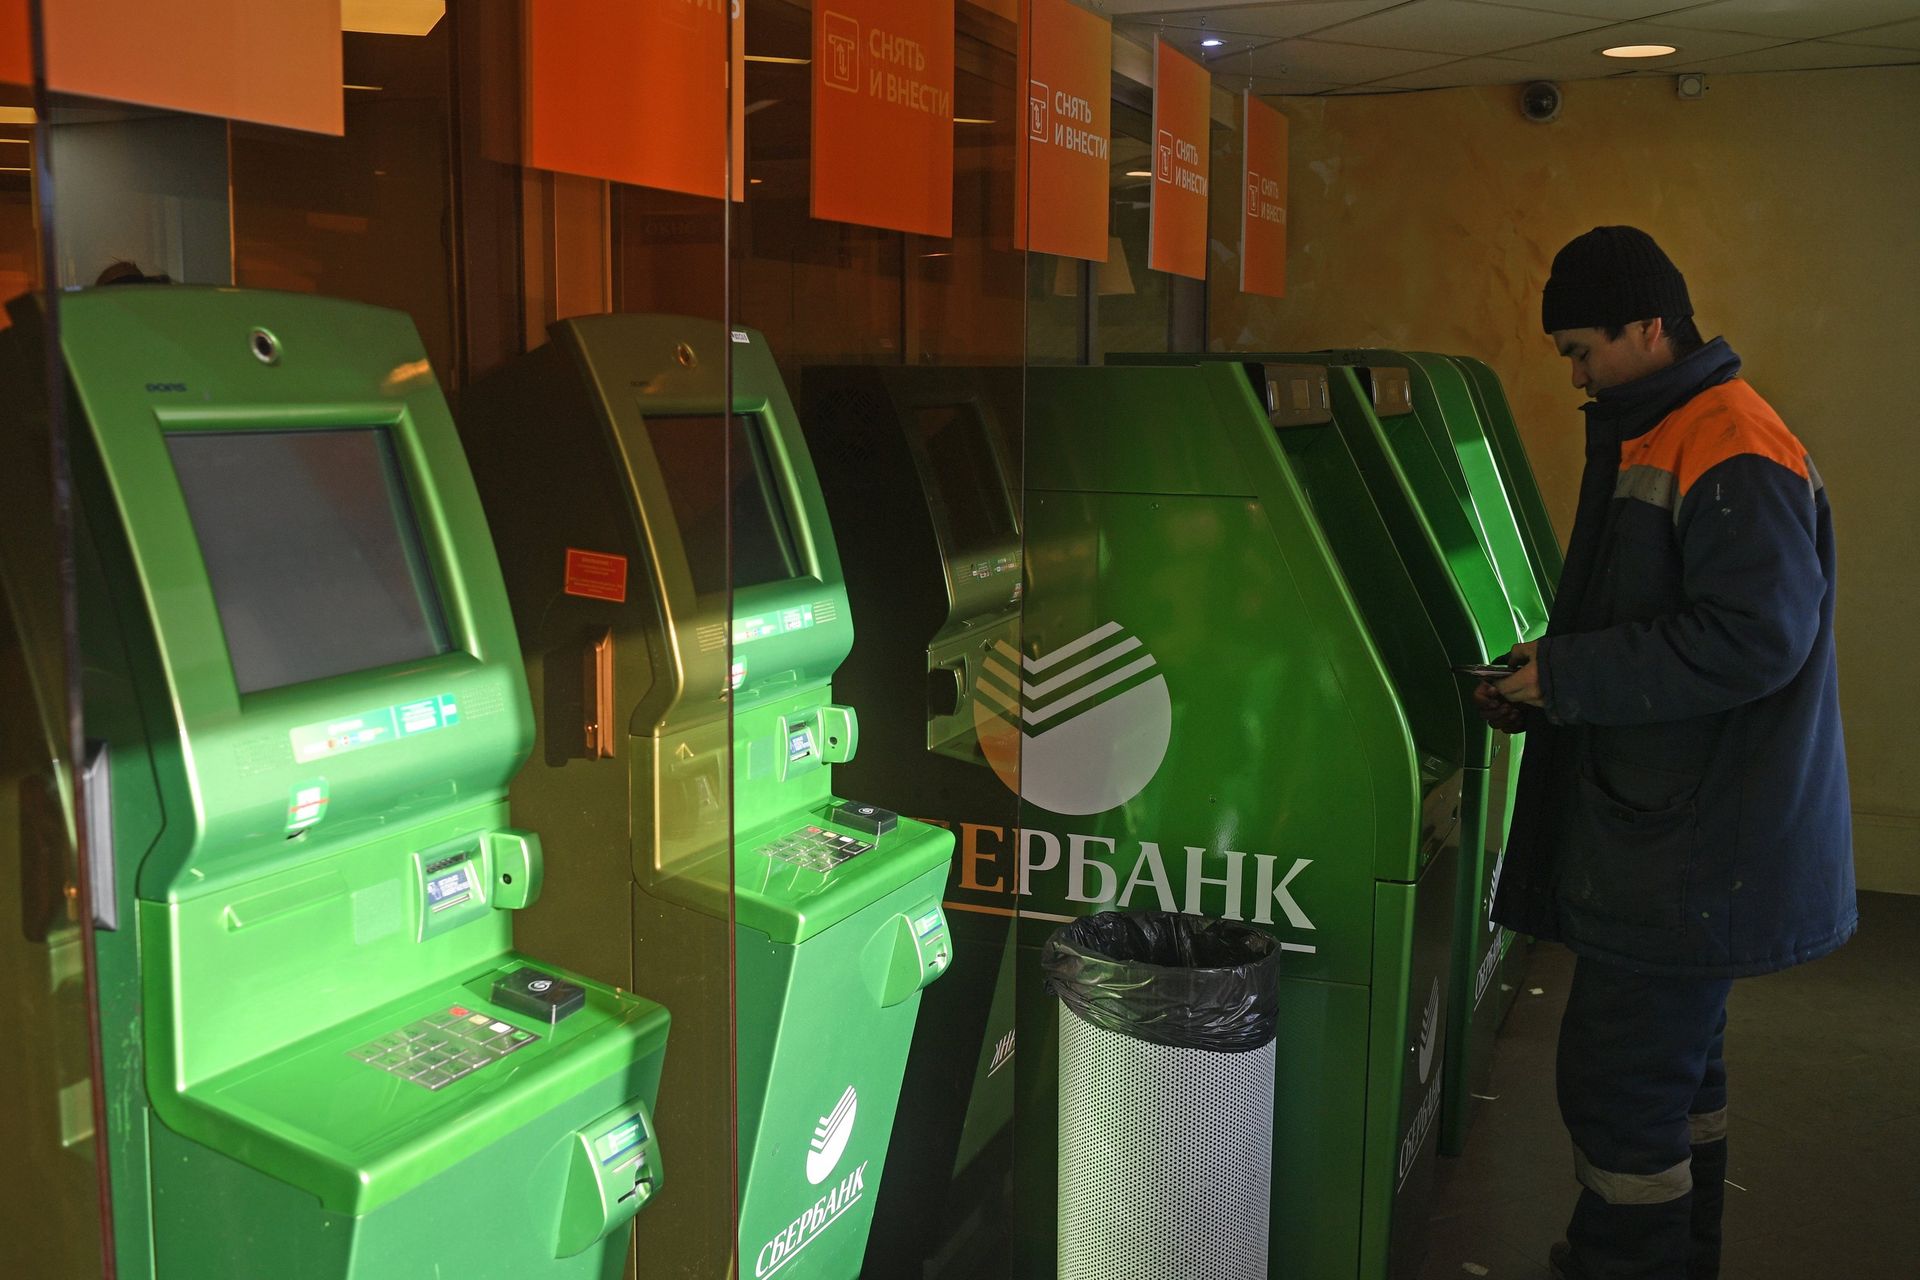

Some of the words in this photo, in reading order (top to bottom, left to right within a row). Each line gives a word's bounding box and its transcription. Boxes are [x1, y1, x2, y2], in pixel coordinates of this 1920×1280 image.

[870, 28, 925, 71] СНЯТЬ
[870, 68, 882, 99] И
[887, 72, 949, 117] ВНЕСТИ
[1055, 90, 1092, 124] СНЯТЬ
[1055, 122, 1064, 147] И
[1066, 126, 1108, 160] ВНЕСТИ
[1176, 139, 1199, 166] СНЯТЬ
[1175, 165, 1181, 187] И
[1182, 168, 1208, 197] ВНЕСТИ
[915, 818, 1317, 930] ЕРБАНК
[755, 1160, 868, 1278] СБЕРБАНК
